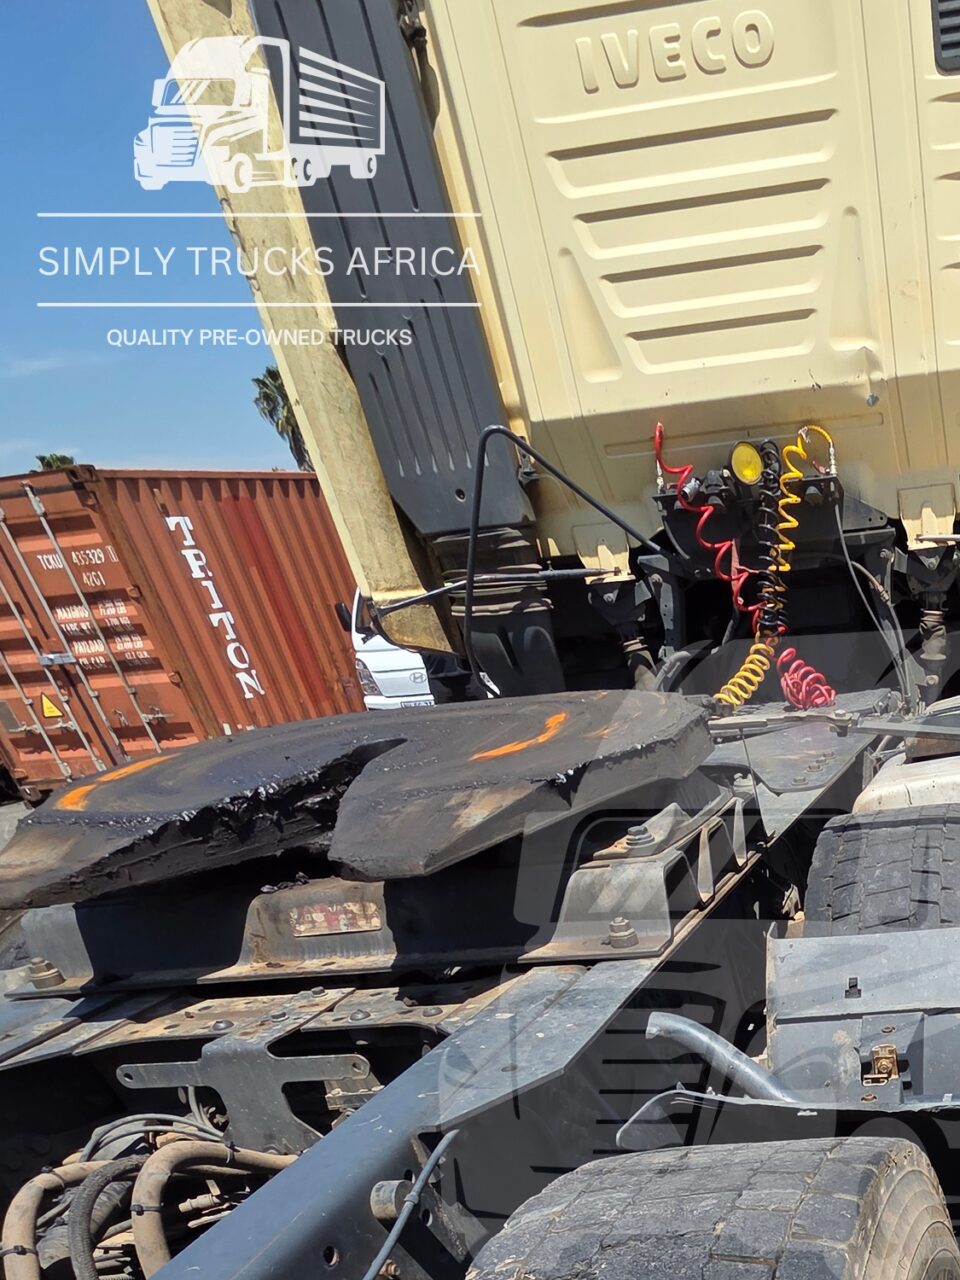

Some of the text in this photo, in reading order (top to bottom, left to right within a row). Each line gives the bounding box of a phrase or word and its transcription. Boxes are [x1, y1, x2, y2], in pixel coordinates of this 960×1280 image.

[575, 9, 774, 94] IVECO
[37, 554, 64, 570] TCKU
[71, 548, 105, 567] 435329
[165, 516, 265, 699] TRITON
